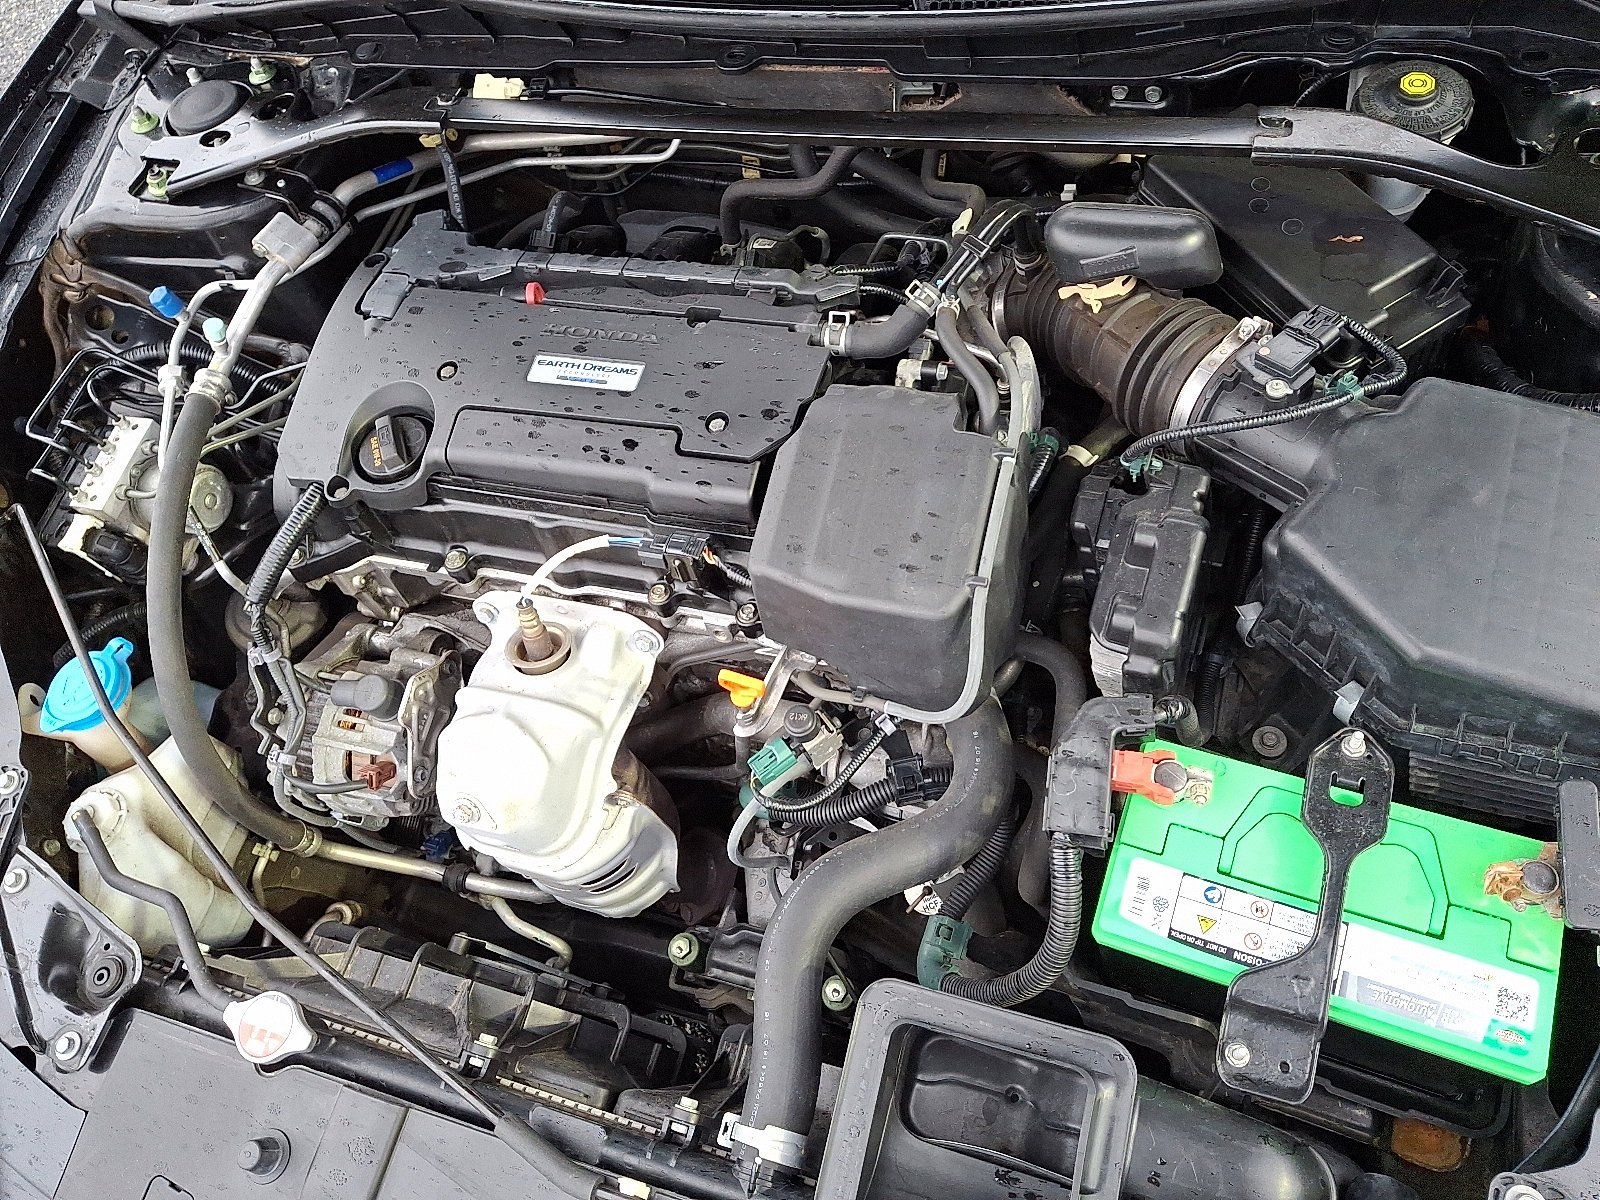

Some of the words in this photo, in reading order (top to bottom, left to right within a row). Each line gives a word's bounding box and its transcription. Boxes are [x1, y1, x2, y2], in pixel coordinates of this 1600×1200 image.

[540, 323, 660, 346] HONDA
[537, 359, 581, 370] EARTH
[370, 436, 379, 449] SAE
[789, 712, 808, 721] 6K12
[1187, 935, 1195, 943] OR
[1195, 937, 1204, 946] TIP
[1206, 942, 1218, 951] NOT
[1218, 945, 1227, 954] DO
[1233, 951, 1268, 966] OISON
[1371, 990, 1435, 1019] AUTOMOTIVE
